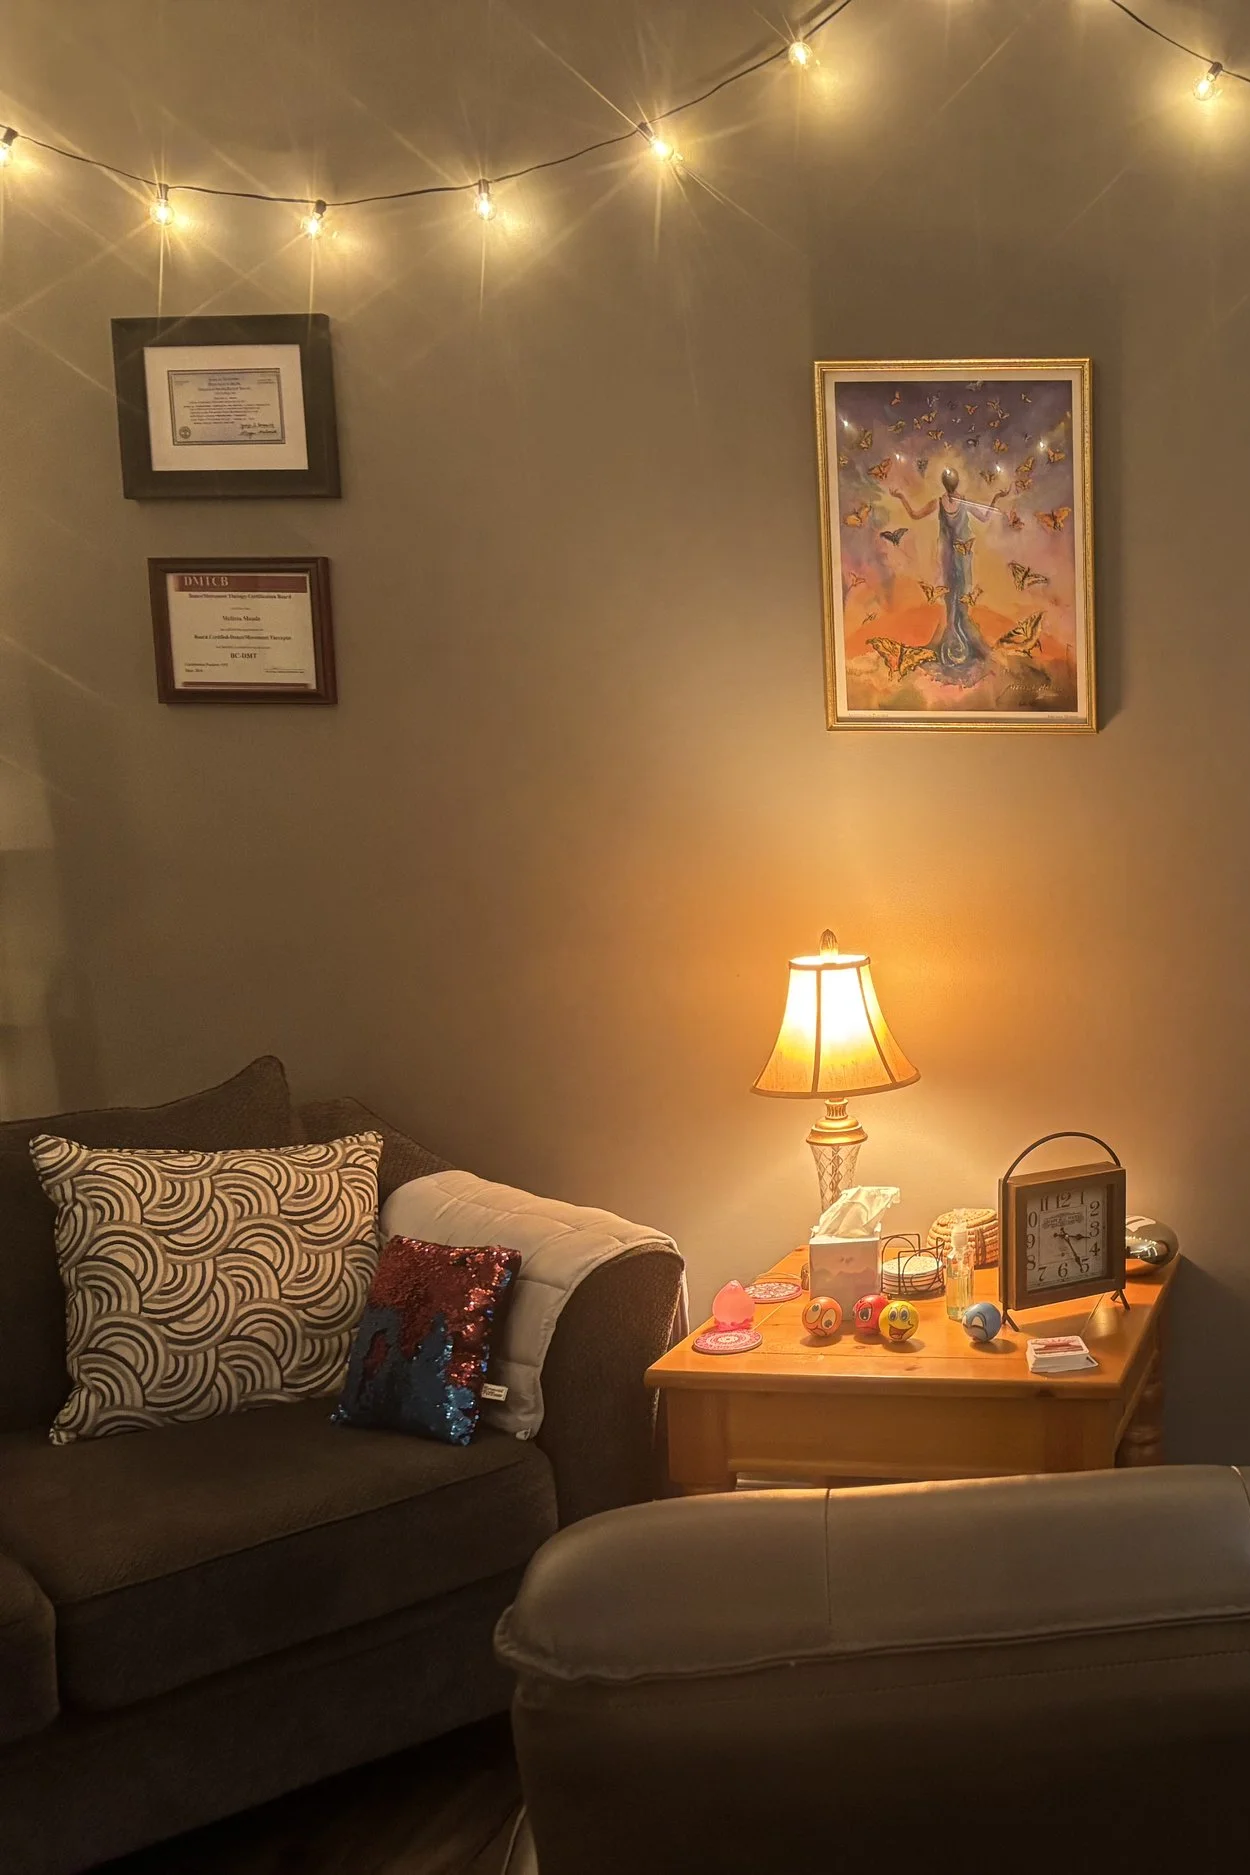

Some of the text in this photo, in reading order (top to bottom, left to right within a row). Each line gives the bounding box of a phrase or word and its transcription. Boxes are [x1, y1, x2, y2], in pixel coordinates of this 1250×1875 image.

[184, 576, 229, 586] DMTCB
[1040, 1195, 1049, 1211] 11
[1056, 1191, 1072, 1209] 12
[1080, 1190, 1085, 1205] 1
[1089, 1200, 1100, 1217] 2
[1028, 1211, 1038, 1228] 0
[1089, 1221, 1100, 1238] 3
[1026, 1233, 1036, 1250] 9
[1089, 1241, 1100, 1257] 4
[1026, 1254, 1036, 1271] 8
[1057, 1262, 1068, 1278] 6
[1080, 1258, 1090, 1273] 5
[1037, 1266, 1047, 1282] 7
